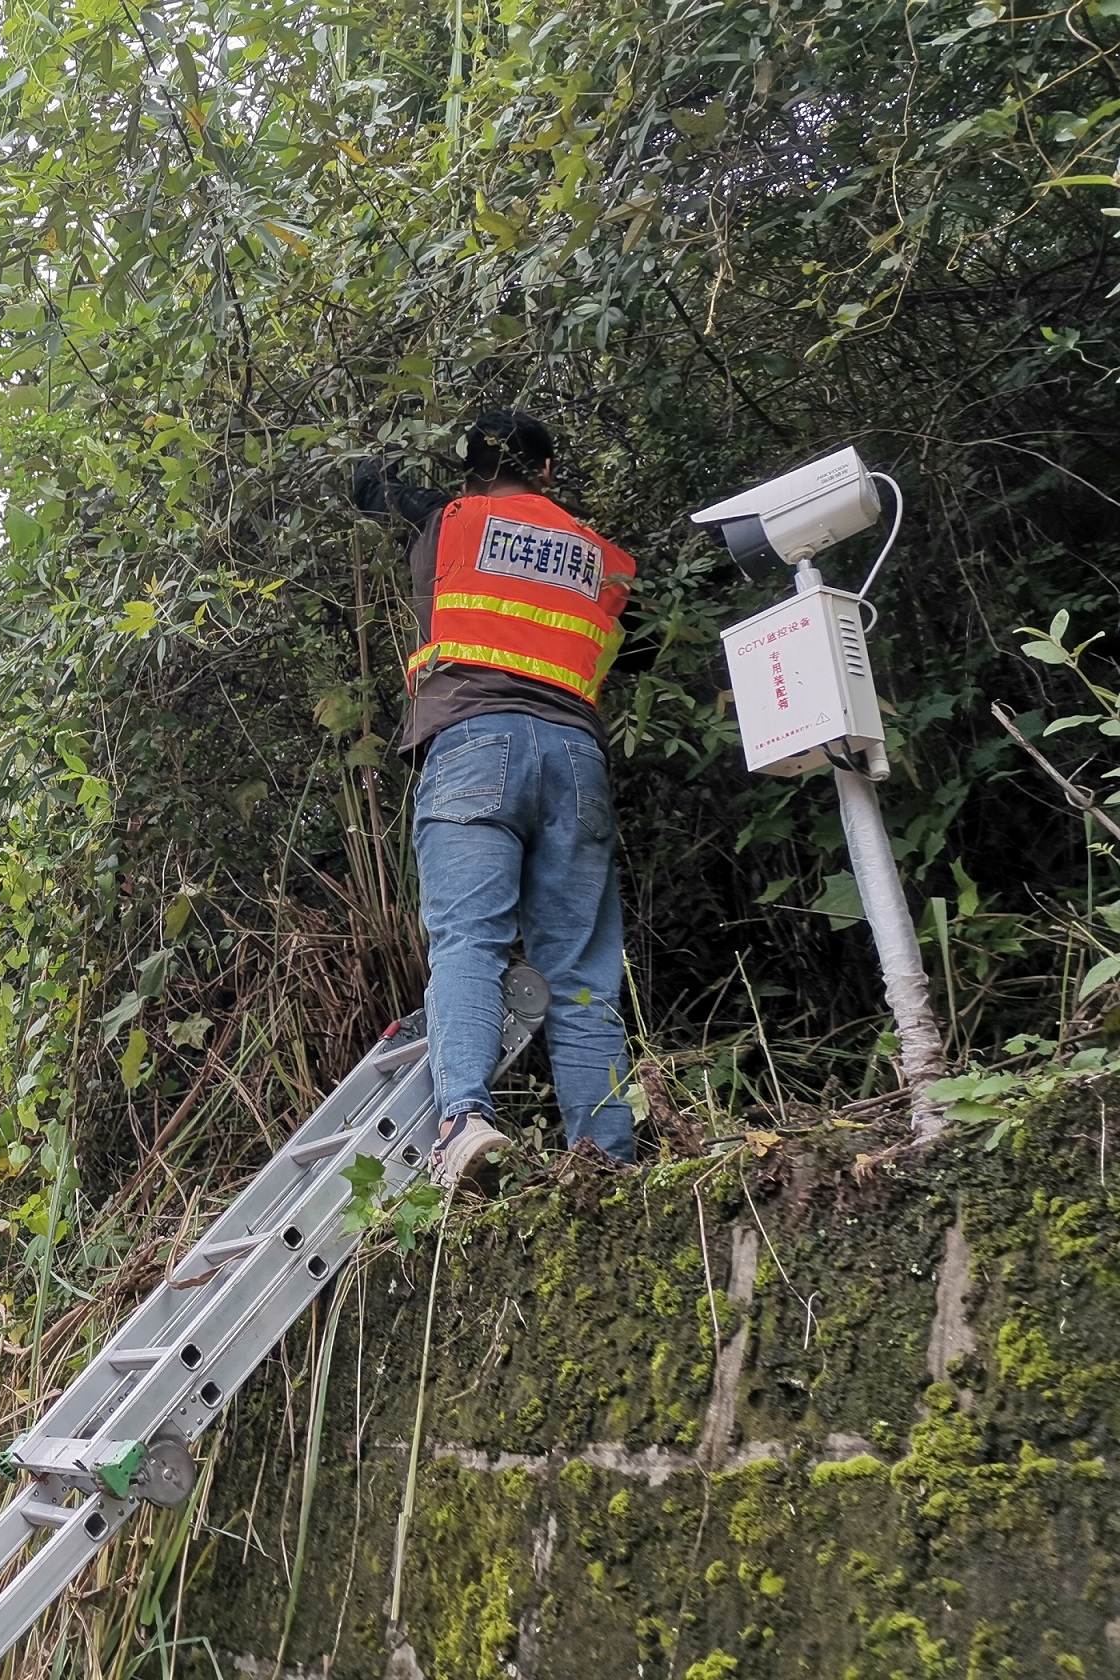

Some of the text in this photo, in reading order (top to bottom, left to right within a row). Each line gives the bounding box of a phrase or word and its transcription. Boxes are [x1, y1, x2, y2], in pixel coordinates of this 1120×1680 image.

[488, 529, 597, 588] ETC车道引导员
